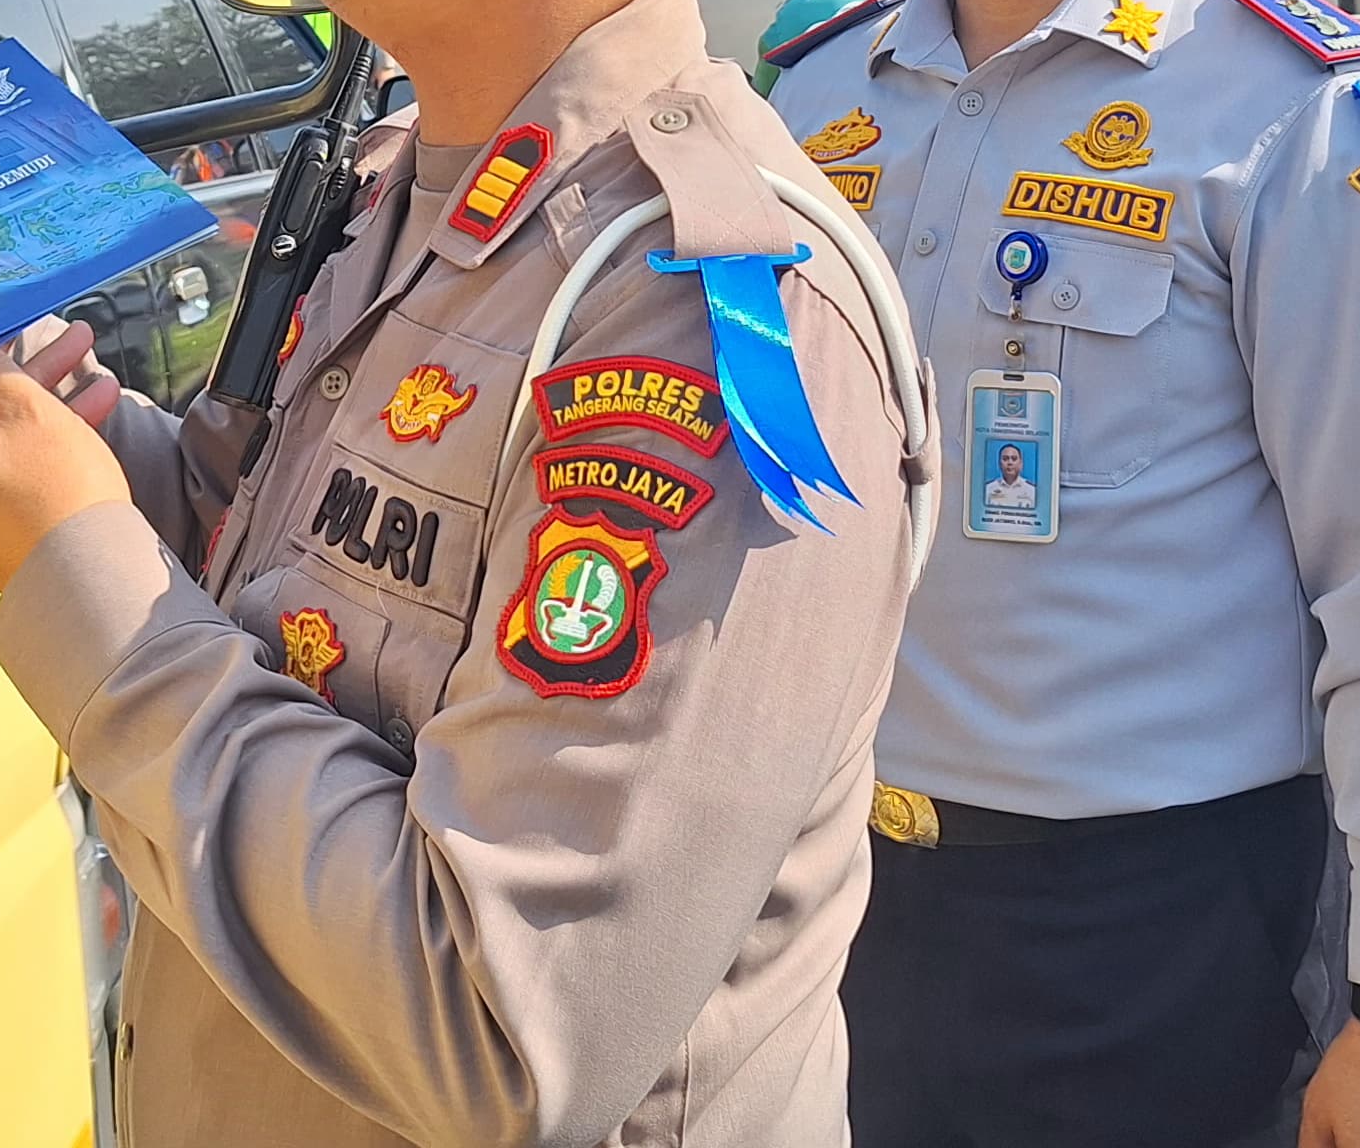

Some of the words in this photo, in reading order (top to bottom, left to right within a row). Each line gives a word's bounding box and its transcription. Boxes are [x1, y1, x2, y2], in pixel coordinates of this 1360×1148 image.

[1014, 180, 1158, 229] DISHUB
[574, 369, 704, 412] POLRES
[553, 396, 645, 426] TANGERANG
[646, 400, 715, 441] SELATAN
[549, 461, 618, 492] METRO
[620, 466, 686, 515] JAYA
[312, 468, 439, 587] POLRI
